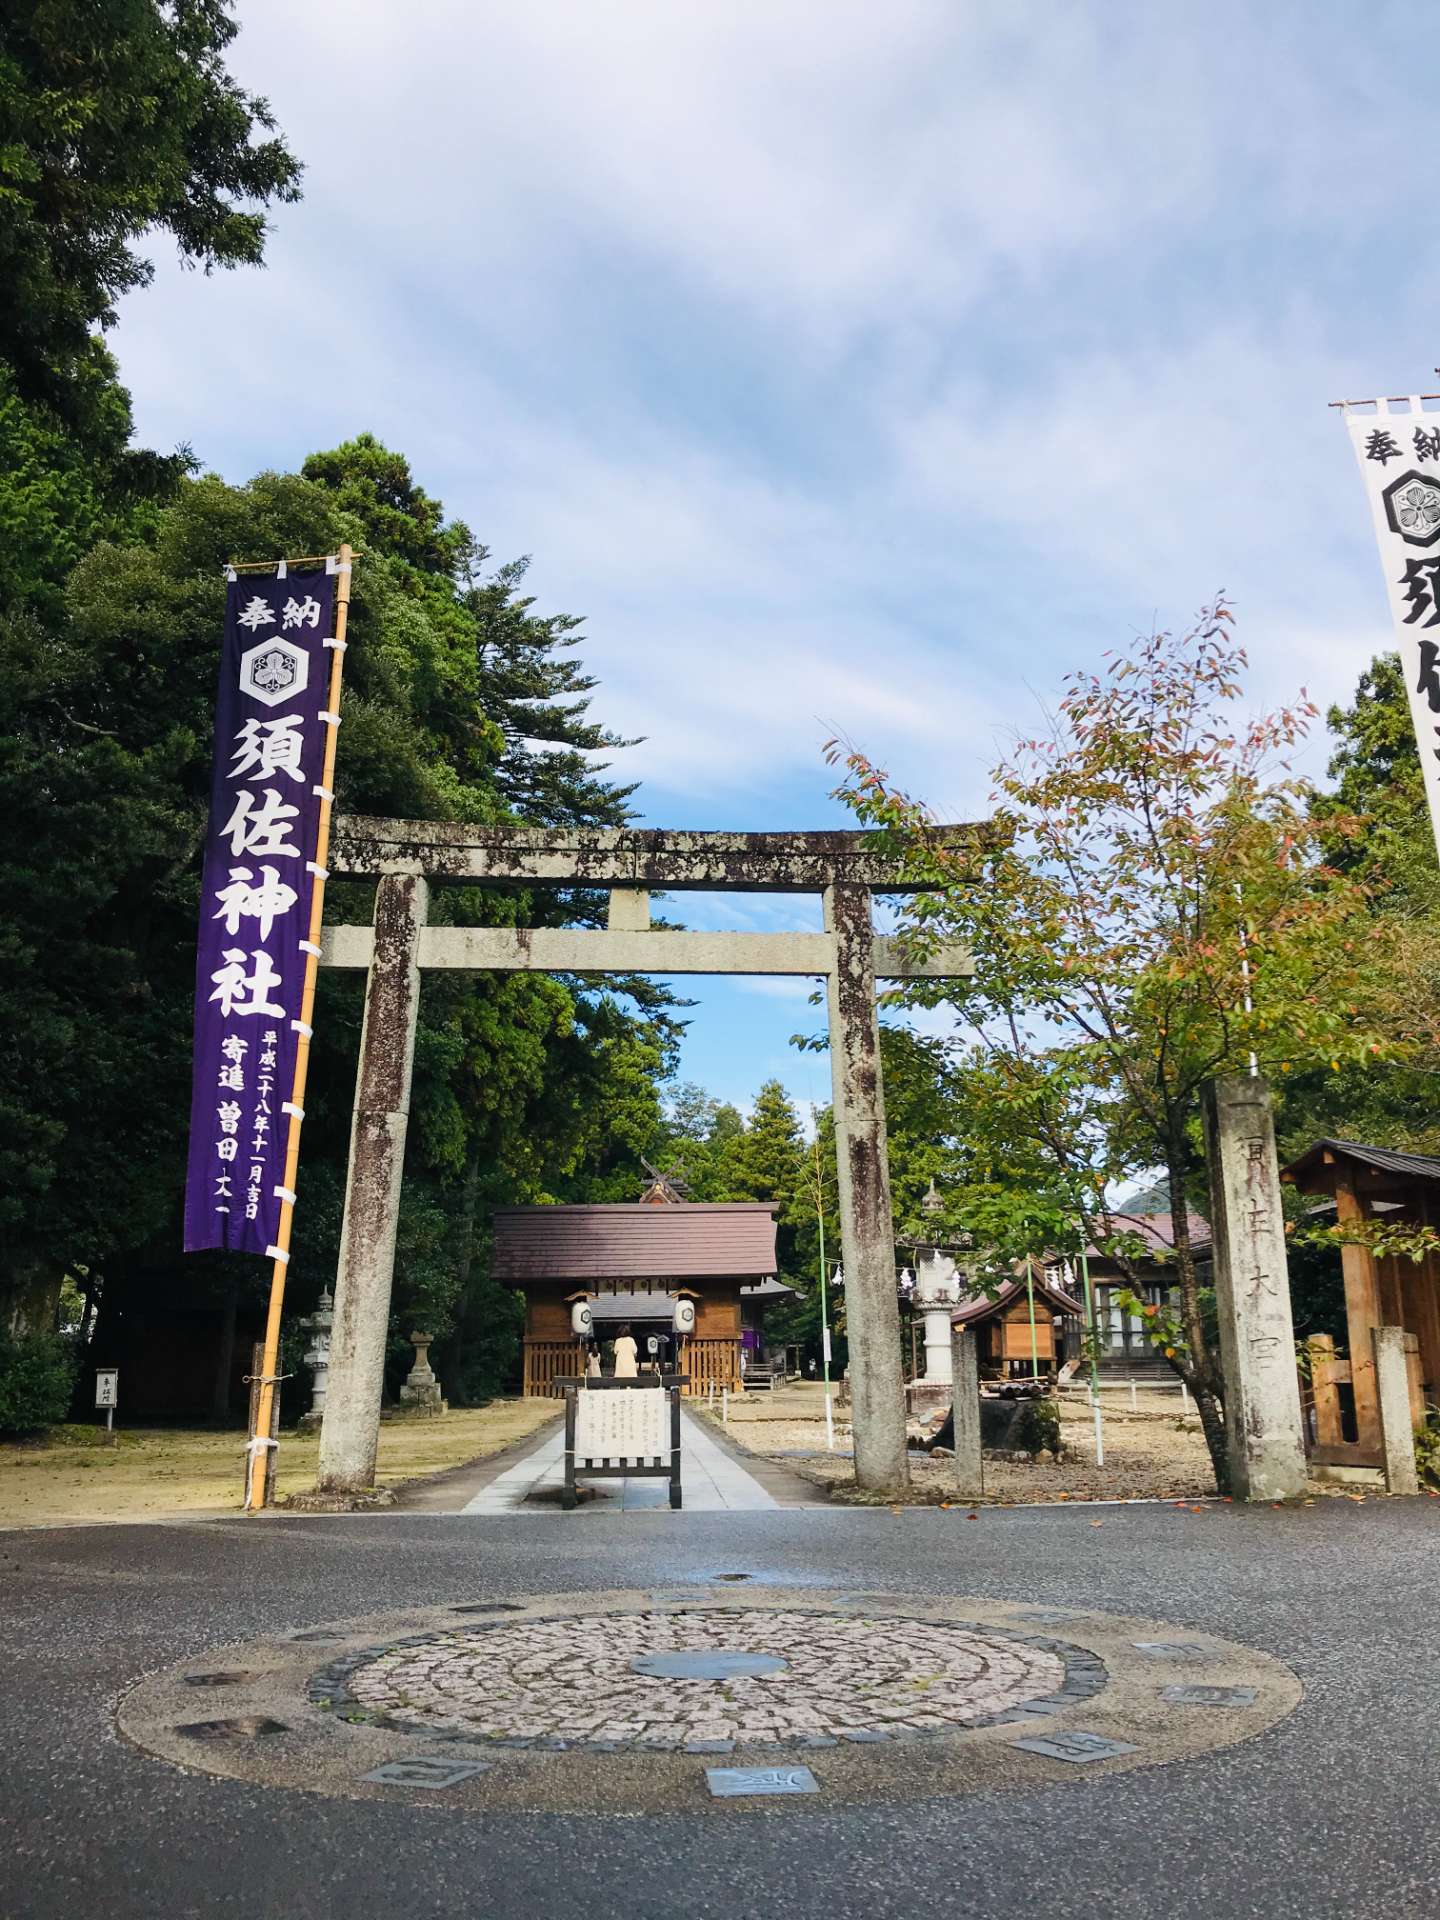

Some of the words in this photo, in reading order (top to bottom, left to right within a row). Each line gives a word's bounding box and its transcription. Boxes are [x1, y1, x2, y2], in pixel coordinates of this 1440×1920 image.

[237, 596, 321, 633] 奉納
[209, 714, 306, 1019] 須佐神社
[217, 1034, 249, 1091] 寄進
[245, 1031, 277, 1219] 平成二十八年十一月吉日
